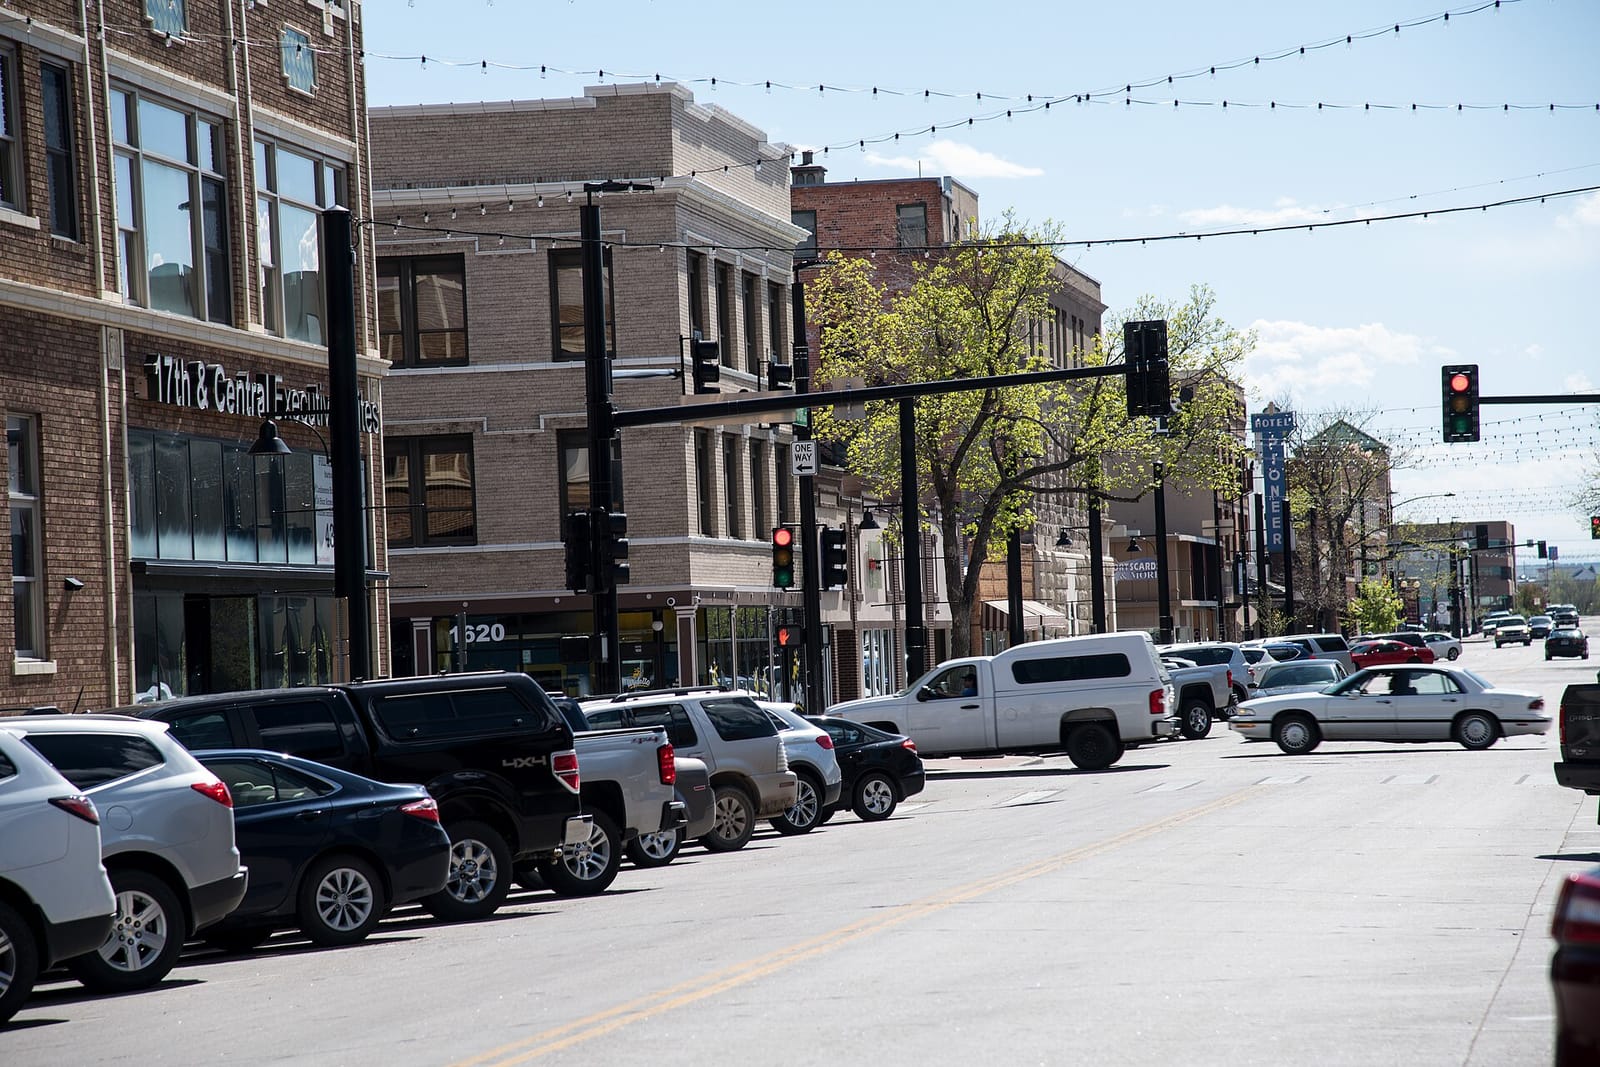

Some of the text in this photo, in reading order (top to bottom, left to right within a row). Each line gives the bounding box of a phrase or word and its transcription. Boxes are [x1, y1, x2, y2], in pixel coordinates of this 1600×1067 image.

[153, 353, 191, 407] 17th
[196, 361, 209, 410] &
[214, 364, 269, 418] Central
[274, 375, 331, 428] Executiv
[1254, 417, 1290, 428] HOTEL
[794, 443, 812, 453] ONE
[794, 453, 812, 462] WAY
[449, 623, 505, 644] 1620
